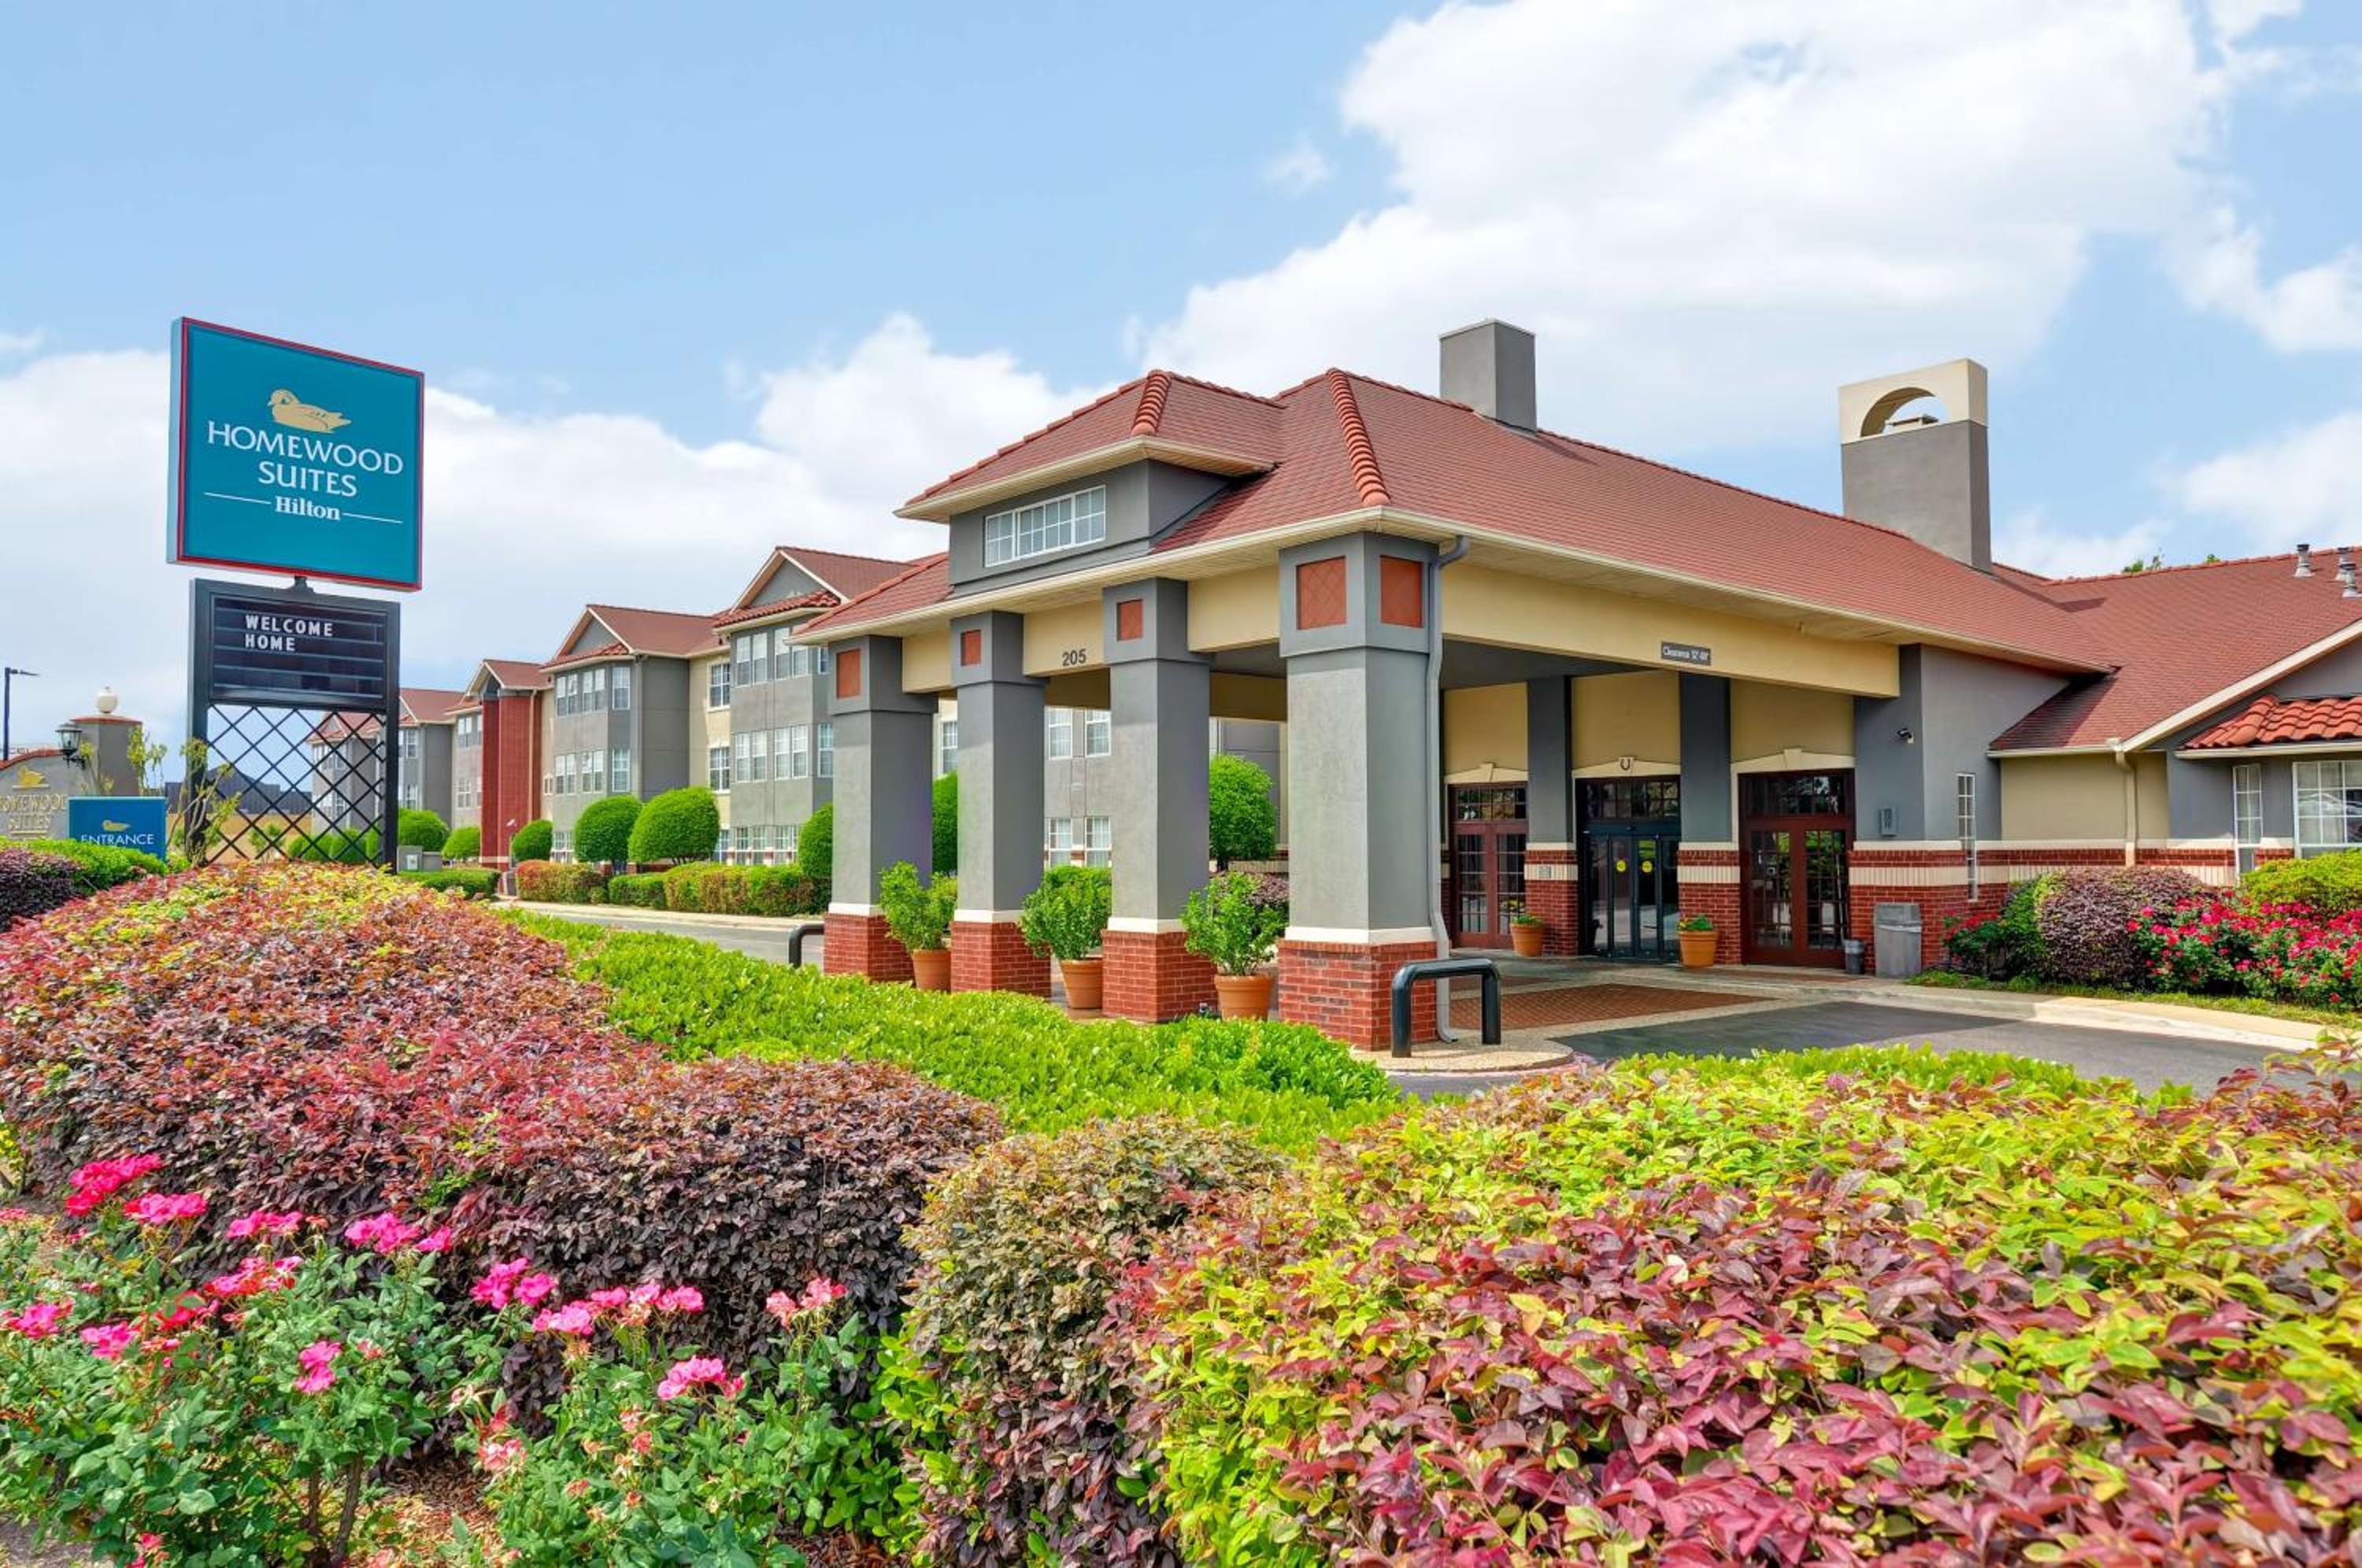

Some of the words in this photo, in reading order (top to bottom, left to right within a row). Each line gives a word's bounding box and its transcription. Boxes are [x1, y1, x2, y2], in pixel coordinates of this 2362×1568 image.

[208, 420, 403, 475] HOMEWOOD
[257, 460, 357, 497] SUITES
[276, 495, 341, 520] Hilton
[245, 615, 333, 637] WELCOME
[245, 634, 296, 652] HOME
[1062, 648, 1087, 667] 205
[81, 834, 154, 845] ENTRANCE
